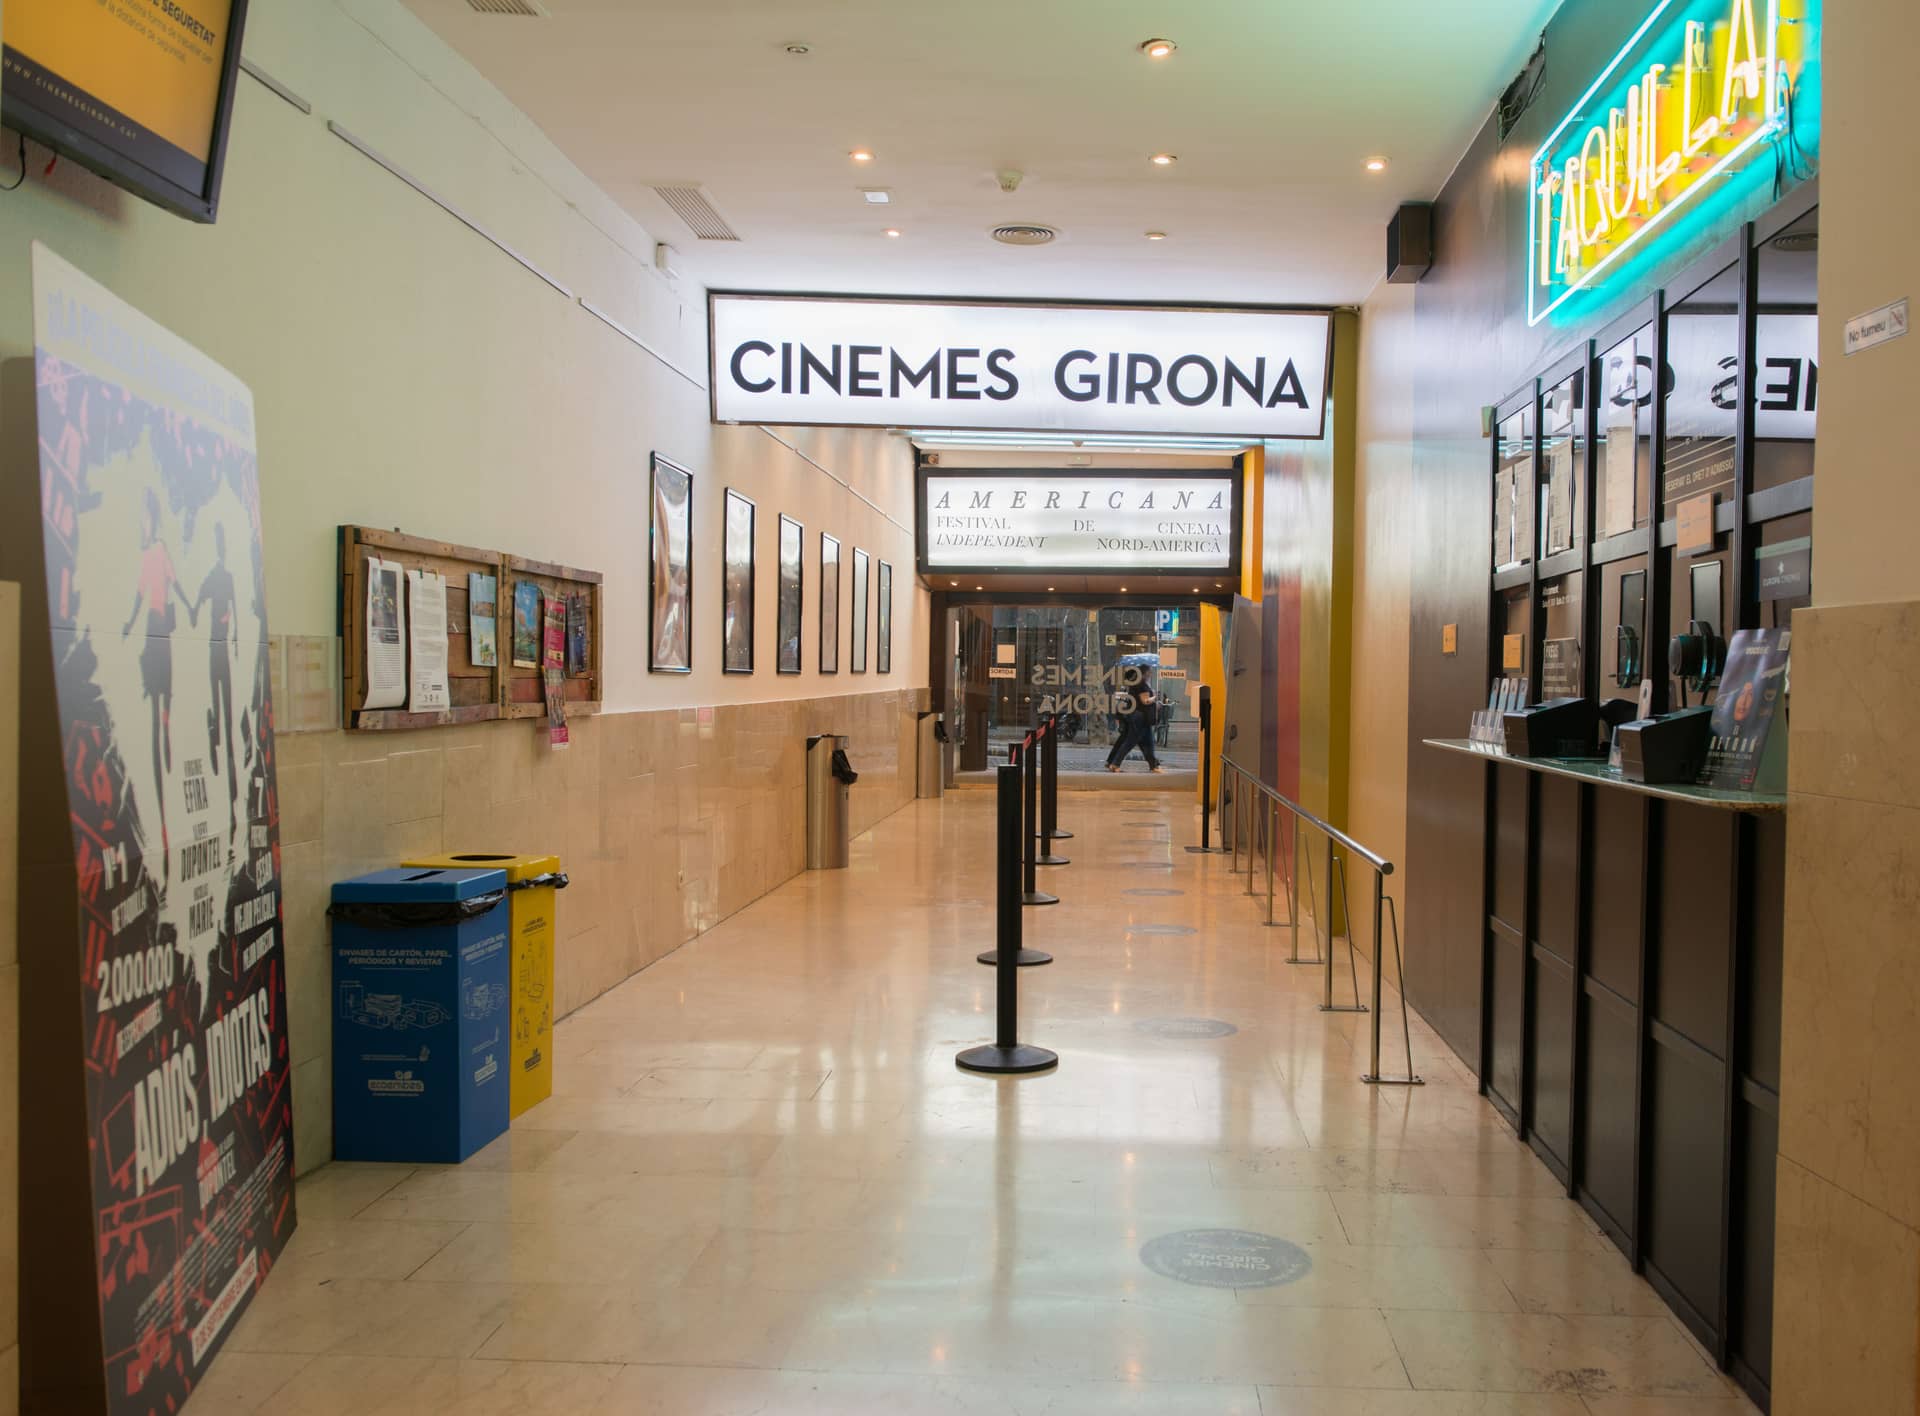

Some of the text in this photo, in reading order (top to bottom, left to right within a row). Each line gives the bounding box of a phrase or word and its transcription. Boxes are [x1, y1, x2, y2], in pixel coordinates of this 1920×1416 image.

[161, 0, 216, 47] SEGURETAT
[1538, 0, 1760, 286] TAQUILLA
[1848, 330, 1860, 344] No
[729, 339, 1311, 410] CINEMES GIRONA
[936, 516, 1223, 536] FESTIVAL DE CINEMA
[936, 534, 1222, 553] INDEPENDENT NORD-AMERICÀ
[1159, 609, 1171, 630] P
[183, 777, 208, 814] EFIRA
[254, 776, 264, 818] 7
[180, 836, 221, 883] DUPONTEL
[188, 896, 215, 940] MARIE
[205, 987, 273, 1123] IDIOTAS
